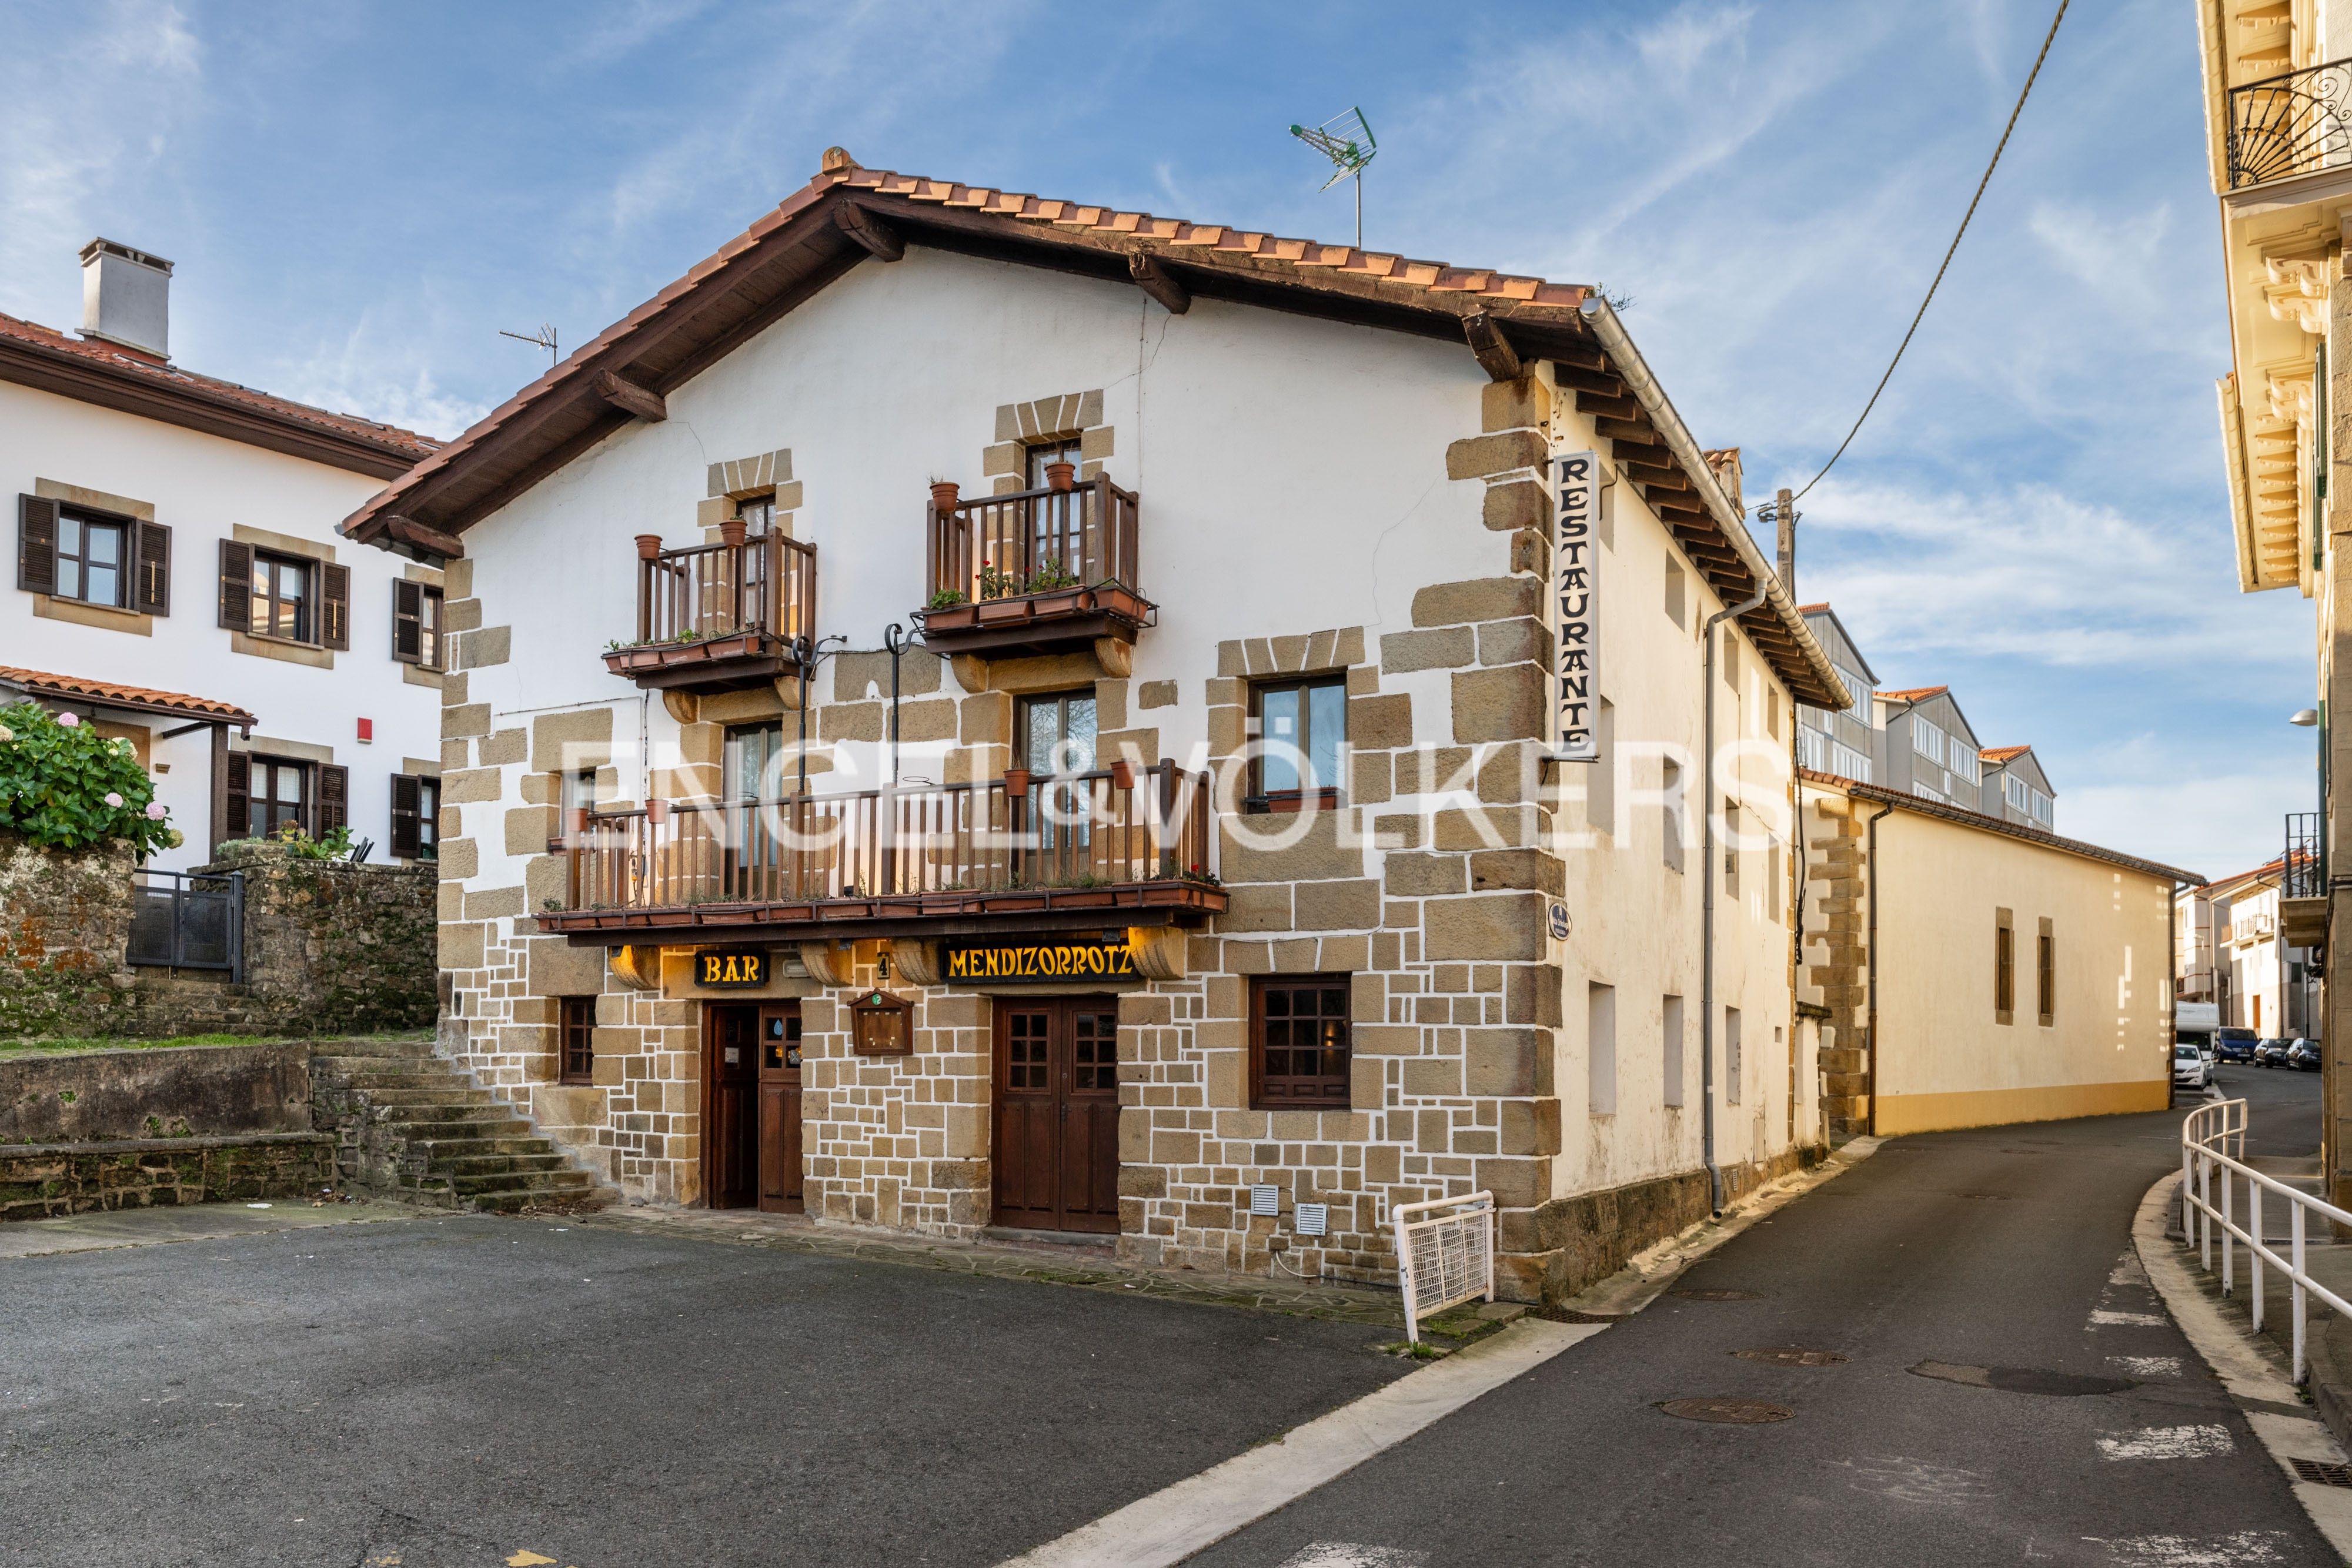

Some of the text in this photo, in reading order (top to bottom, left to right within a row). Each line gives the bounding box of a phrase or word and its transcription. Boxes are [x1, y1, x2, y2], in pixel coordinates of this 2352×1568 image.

[1560, 459, 1590, 753] RESTAURANTE
[704, 955, 760, 982] BAR
[878, 958, 887, 976] 4
[948, 944, 1133, 977] MENDIZORROTZ
